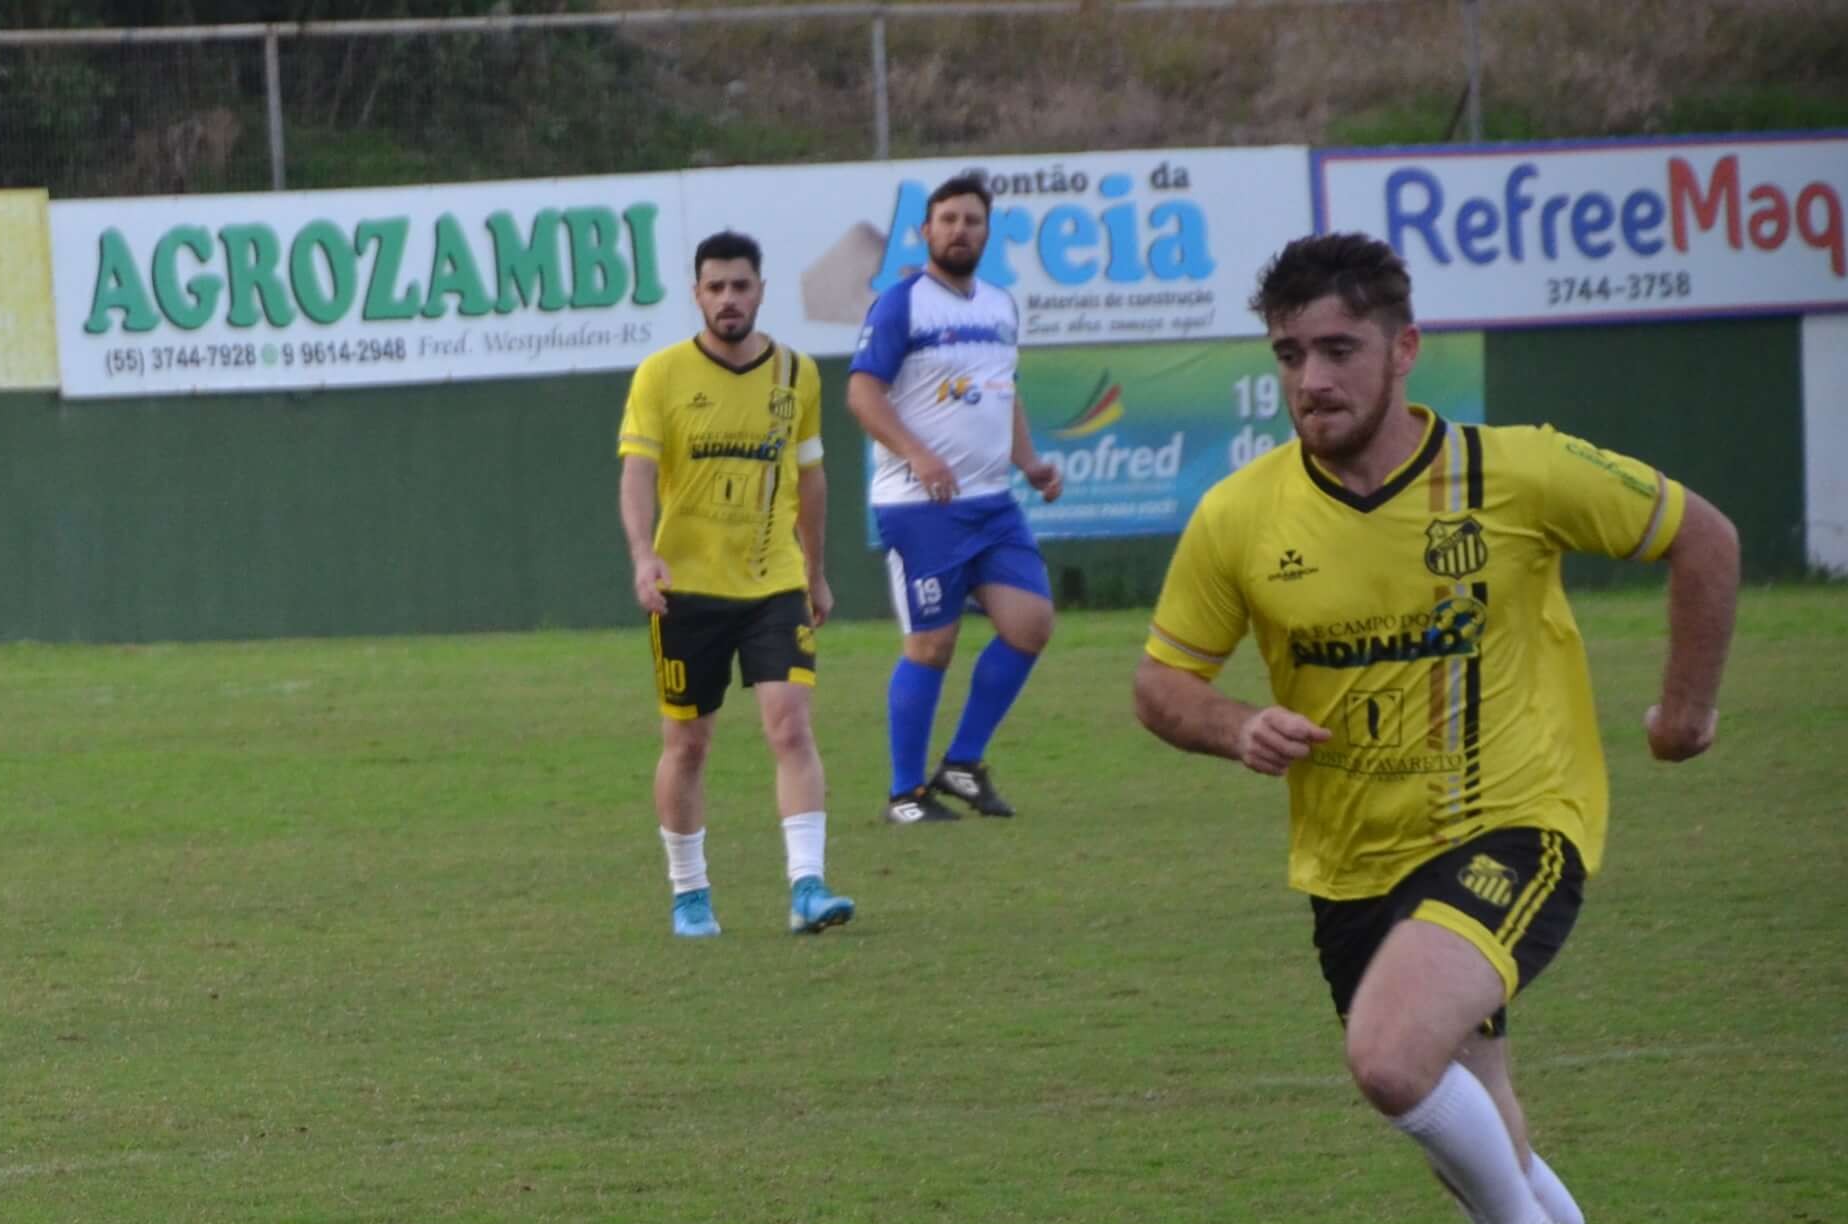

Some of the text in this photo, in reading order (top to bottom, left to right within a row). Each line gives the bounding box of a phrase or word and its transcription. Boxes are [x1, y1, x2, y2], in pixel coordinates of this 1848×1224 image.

[964, 162, 1190, 195] ontão da
[1384, 155, 1847, 278] RefreeMaq
[84, 202, 666, 334] AGROZAMBI
[1547, 273, 1692, 304] 3744-3758
[105, 344, 145, 376] (55)
[151, 342, 257, 369] 3744-7928
[301, 337, 407, 364] 9614-2948
[416, 334, 473, 359] Fred.
[663, 657, 687, 694] 10
